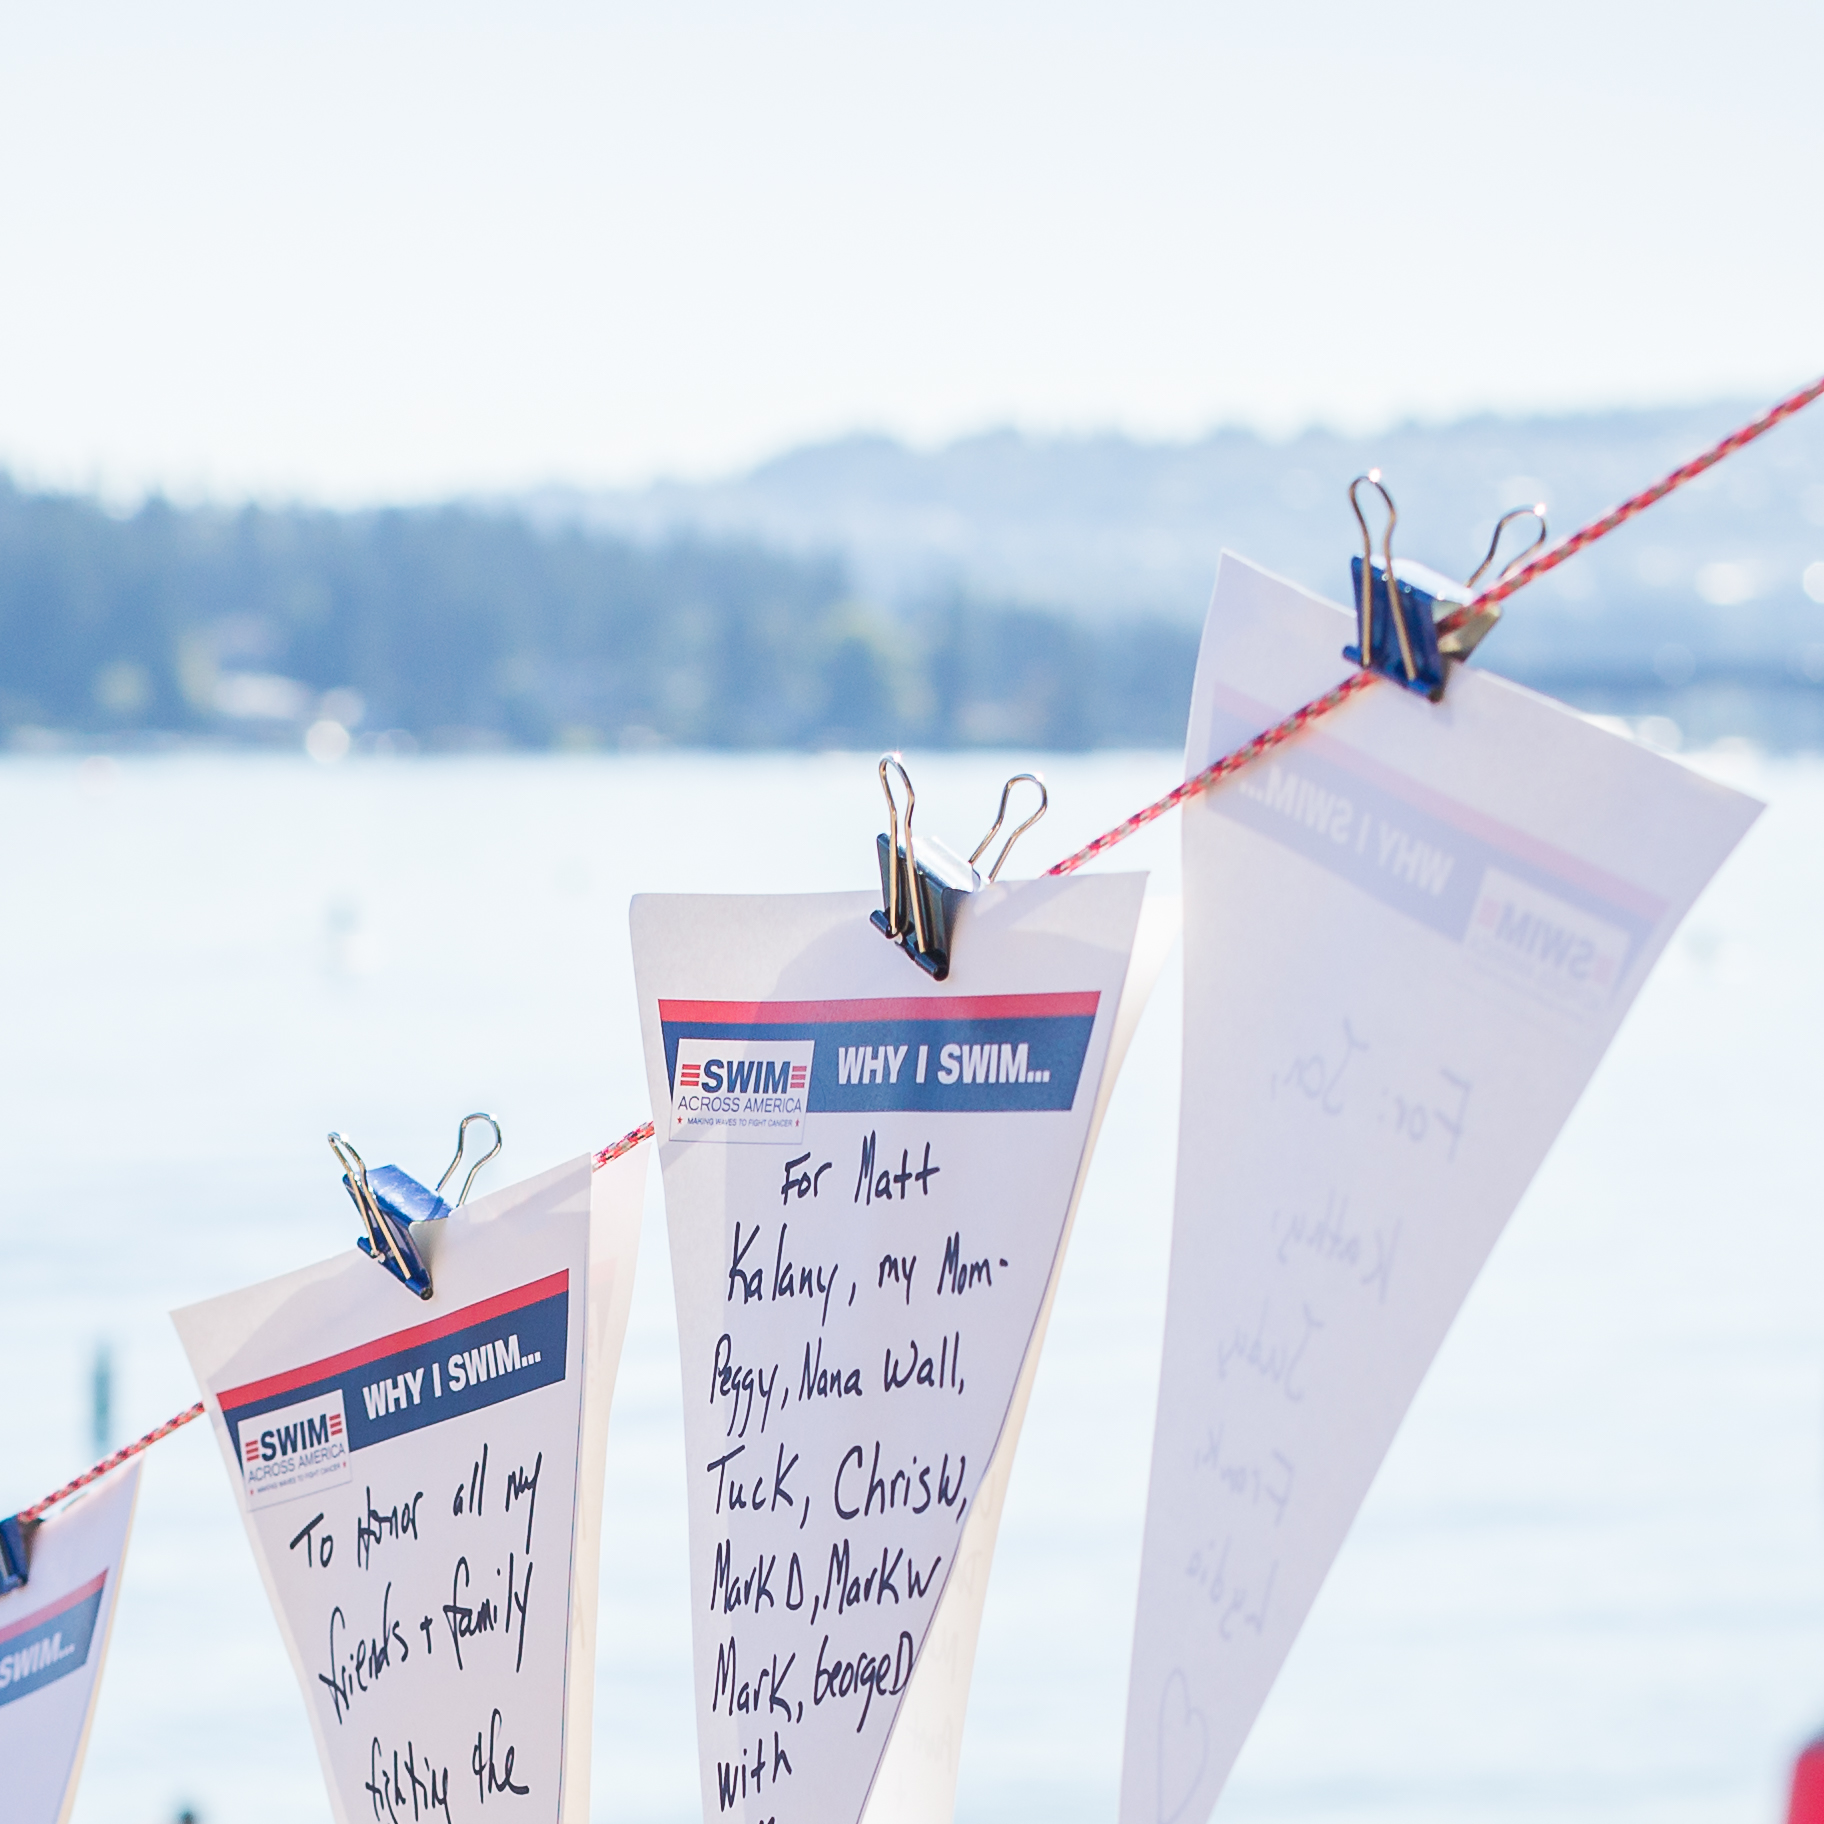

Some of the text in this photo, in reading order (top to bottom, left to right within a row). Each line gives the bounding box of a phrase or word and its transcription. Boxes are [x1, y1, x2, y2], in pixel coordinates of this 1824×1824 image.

[701, 1059, 791, 1094] SWIM
[837, 1042, 1051, 1085] WHY I SWIM...
[678, 1095, 801, 1113] ACROSS AMERICA
[782, 1130, 940, 1205] For Matt
[878, 1254, 916, 1305] my
[361, 1334, 542, 1421] WHY I SWIM...
[709, 1333, 789, 1438] Peggy,
[798, 1337, 863, 1402] Nana
[248, 1458, 295, 1483] ACROSS
[298, 1443, 346, 1469] AMERICA
[261, 1414, 329, 1461] SWIM
[289, 1513, 334, 1568] To
[453, 1443, 488, 1516] all
[319, 1582, 409, 1725] friends
[442, 1552, 533, 1673] family
[472, 1708, 529, 1804] the
